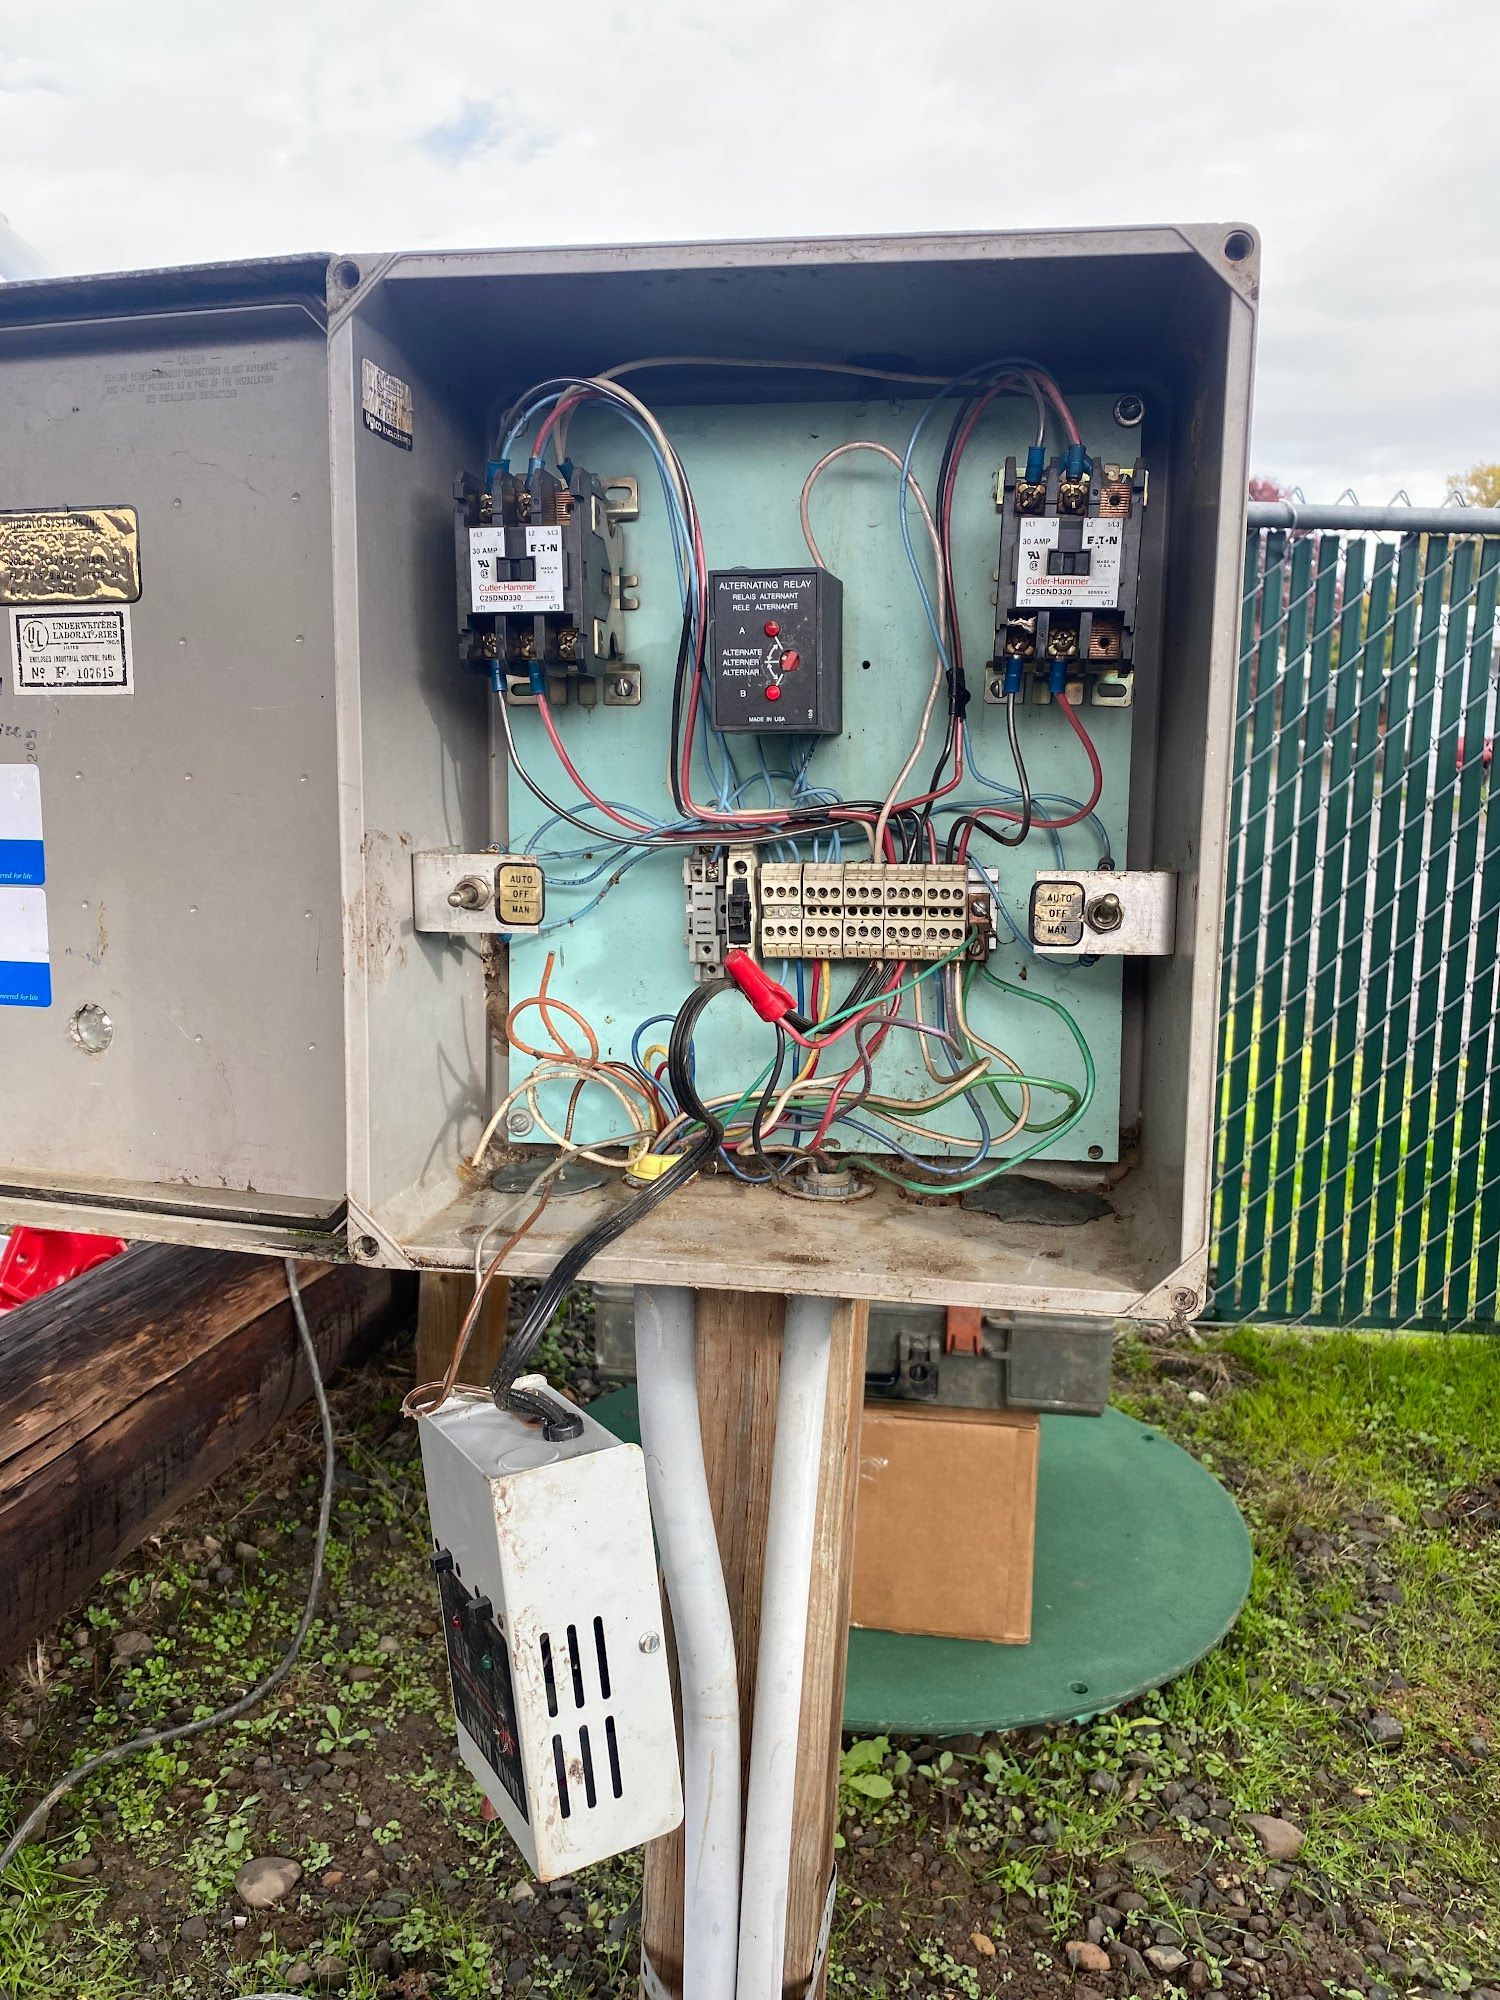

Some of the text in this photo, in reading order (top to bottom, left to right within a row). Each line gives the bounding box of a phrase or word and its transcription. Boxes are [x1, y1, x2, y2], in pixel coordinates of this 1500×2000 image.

[719, 580, 811, 590] ALTERNATING RELAY
[1026, 577, 1089, 585] Cutler-Hammer
[479, 584, 536, 592] Cutler-Hammer
[479, 594, 522, 602] C25DND330
[732, 592, 799, 601] RELAIS ALTERNANT
[755, 603, 799, 611] ALTERNANTE
[52, 620, 118, 630] UNDERWRITERS
[739, 626, 746, 634] A
[77, 666, 114, 679] 107615
[510, 876, 533, 884] AUTO
[513, 890, 530, 898] OFF
[1047, 893, 1072, 903] AUTO
[512, 905, 530, 914] MAN
[1049, 909, 1068, 918] OFF
[1048, 926, 1067, 934] MAN
